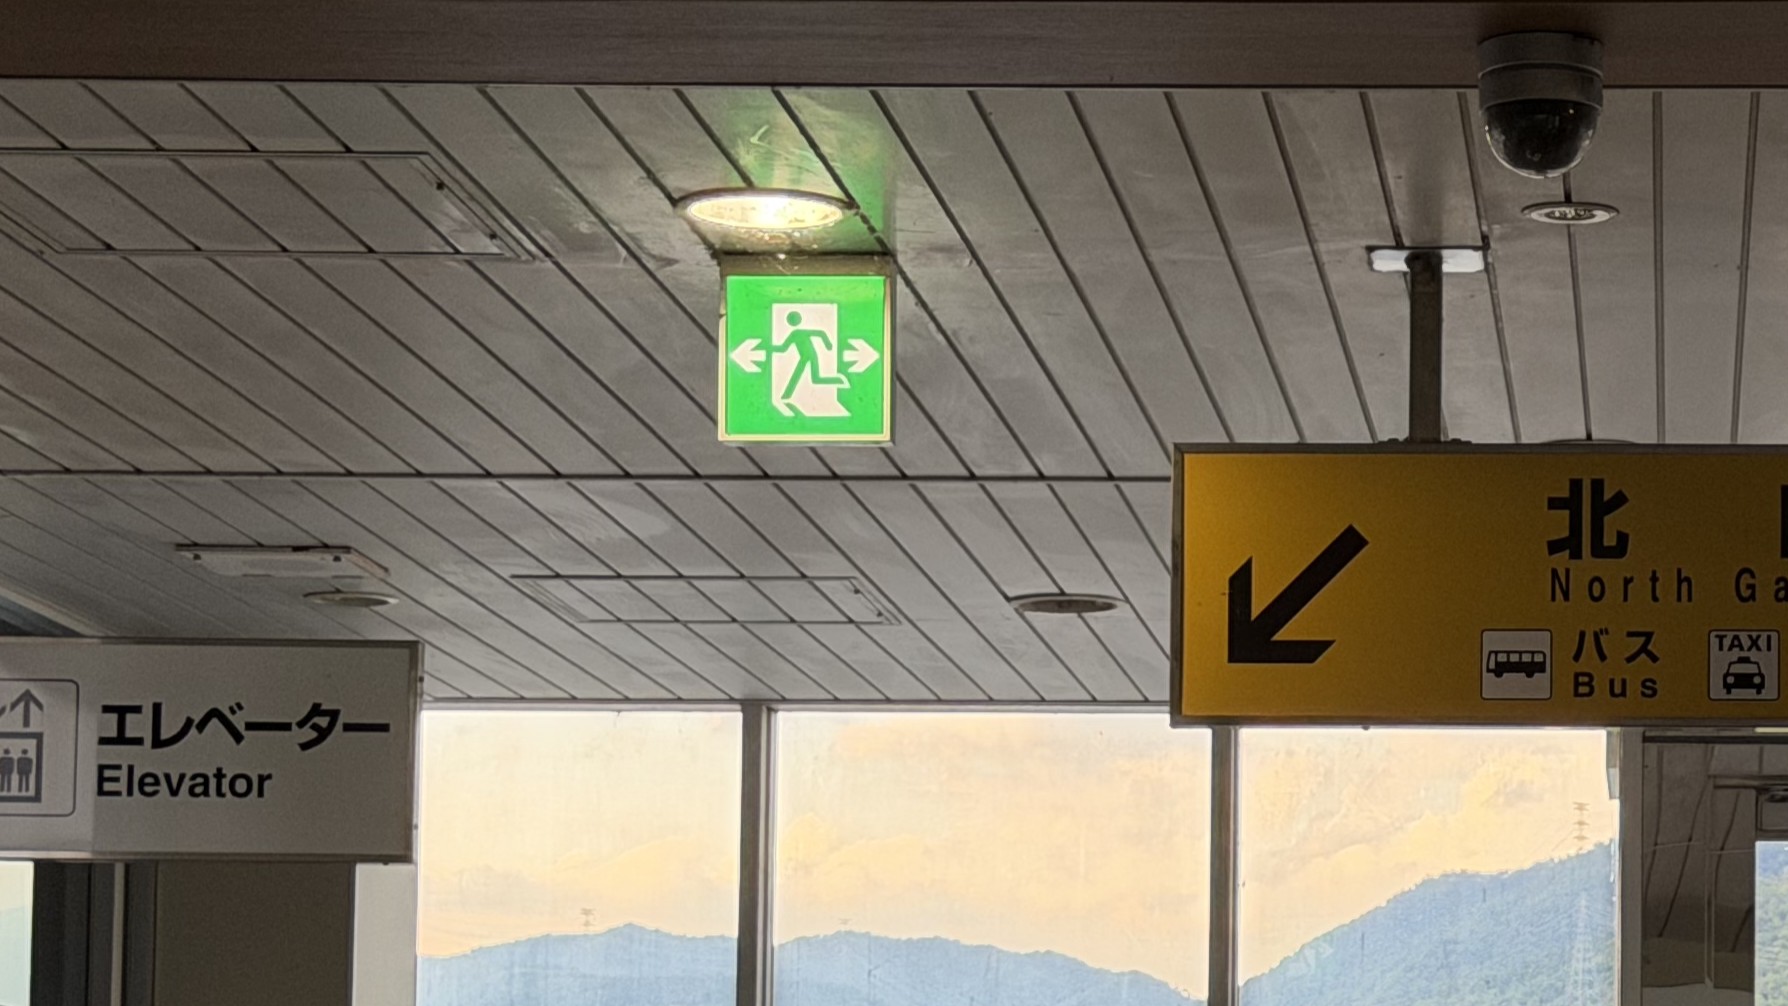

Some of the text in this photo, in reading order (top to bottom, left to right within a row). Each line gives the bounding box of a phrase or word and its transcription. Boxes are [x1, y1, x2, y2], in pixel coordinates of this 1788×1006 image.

[1550, 566, 1694, 603] North
[1571, 627, 1661, 665] バス
[1714, 634, 1773, 653] TAXI
[1572, 671, 1659, 699] Bus
[97, 701, 391, 752] エレベーター
[97, 763, 273, 799] Elevator
